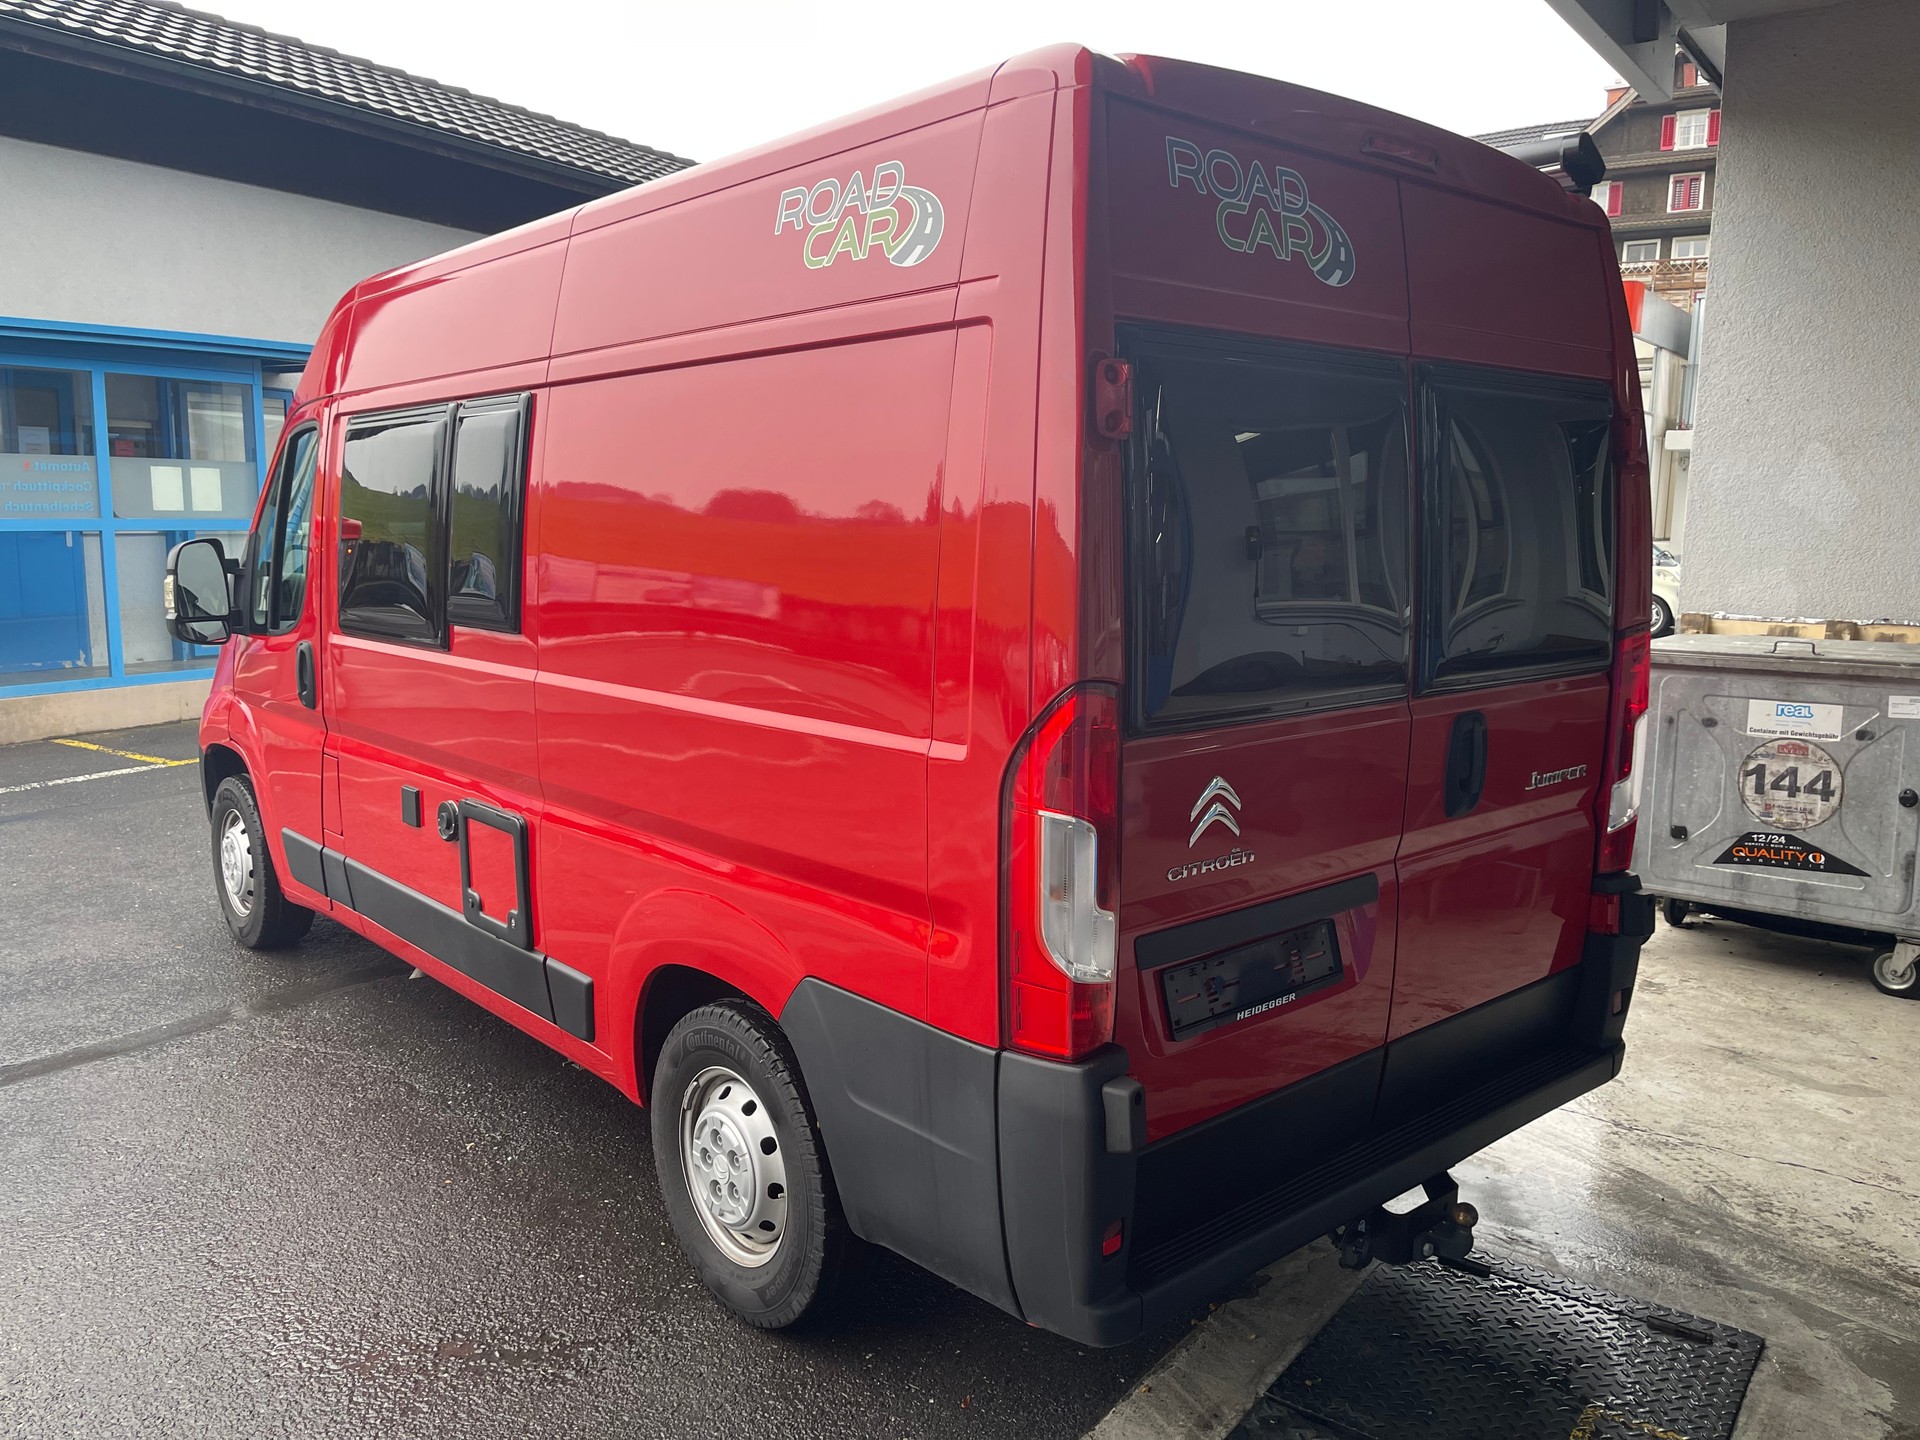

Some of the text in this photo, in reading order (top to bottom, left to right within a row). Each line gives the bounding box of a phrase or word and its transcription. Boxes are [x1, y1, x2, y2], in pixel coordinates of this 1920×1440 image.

[1166, 136, 1309, 217] ROAD
[775, 160, 905, 235] ROAD
[803, 207, 901, 269] CAR
[1216, 199, 1322, 271] CAR
[1776, 704, 1814, 718] real
[1749, 727, 1778, 735] Container
[1790, 730, 1839, 740] Gewichtsgebühr
[1745, 763, 1836, 803] 144
[1732, 846, 1808, 862] QUALITY
[1752, 834, 1787, 845] 12/24
[1236, 992, 1297, 1021] HEIDEGGER
[686, 1030, 741, 1060] Continental
